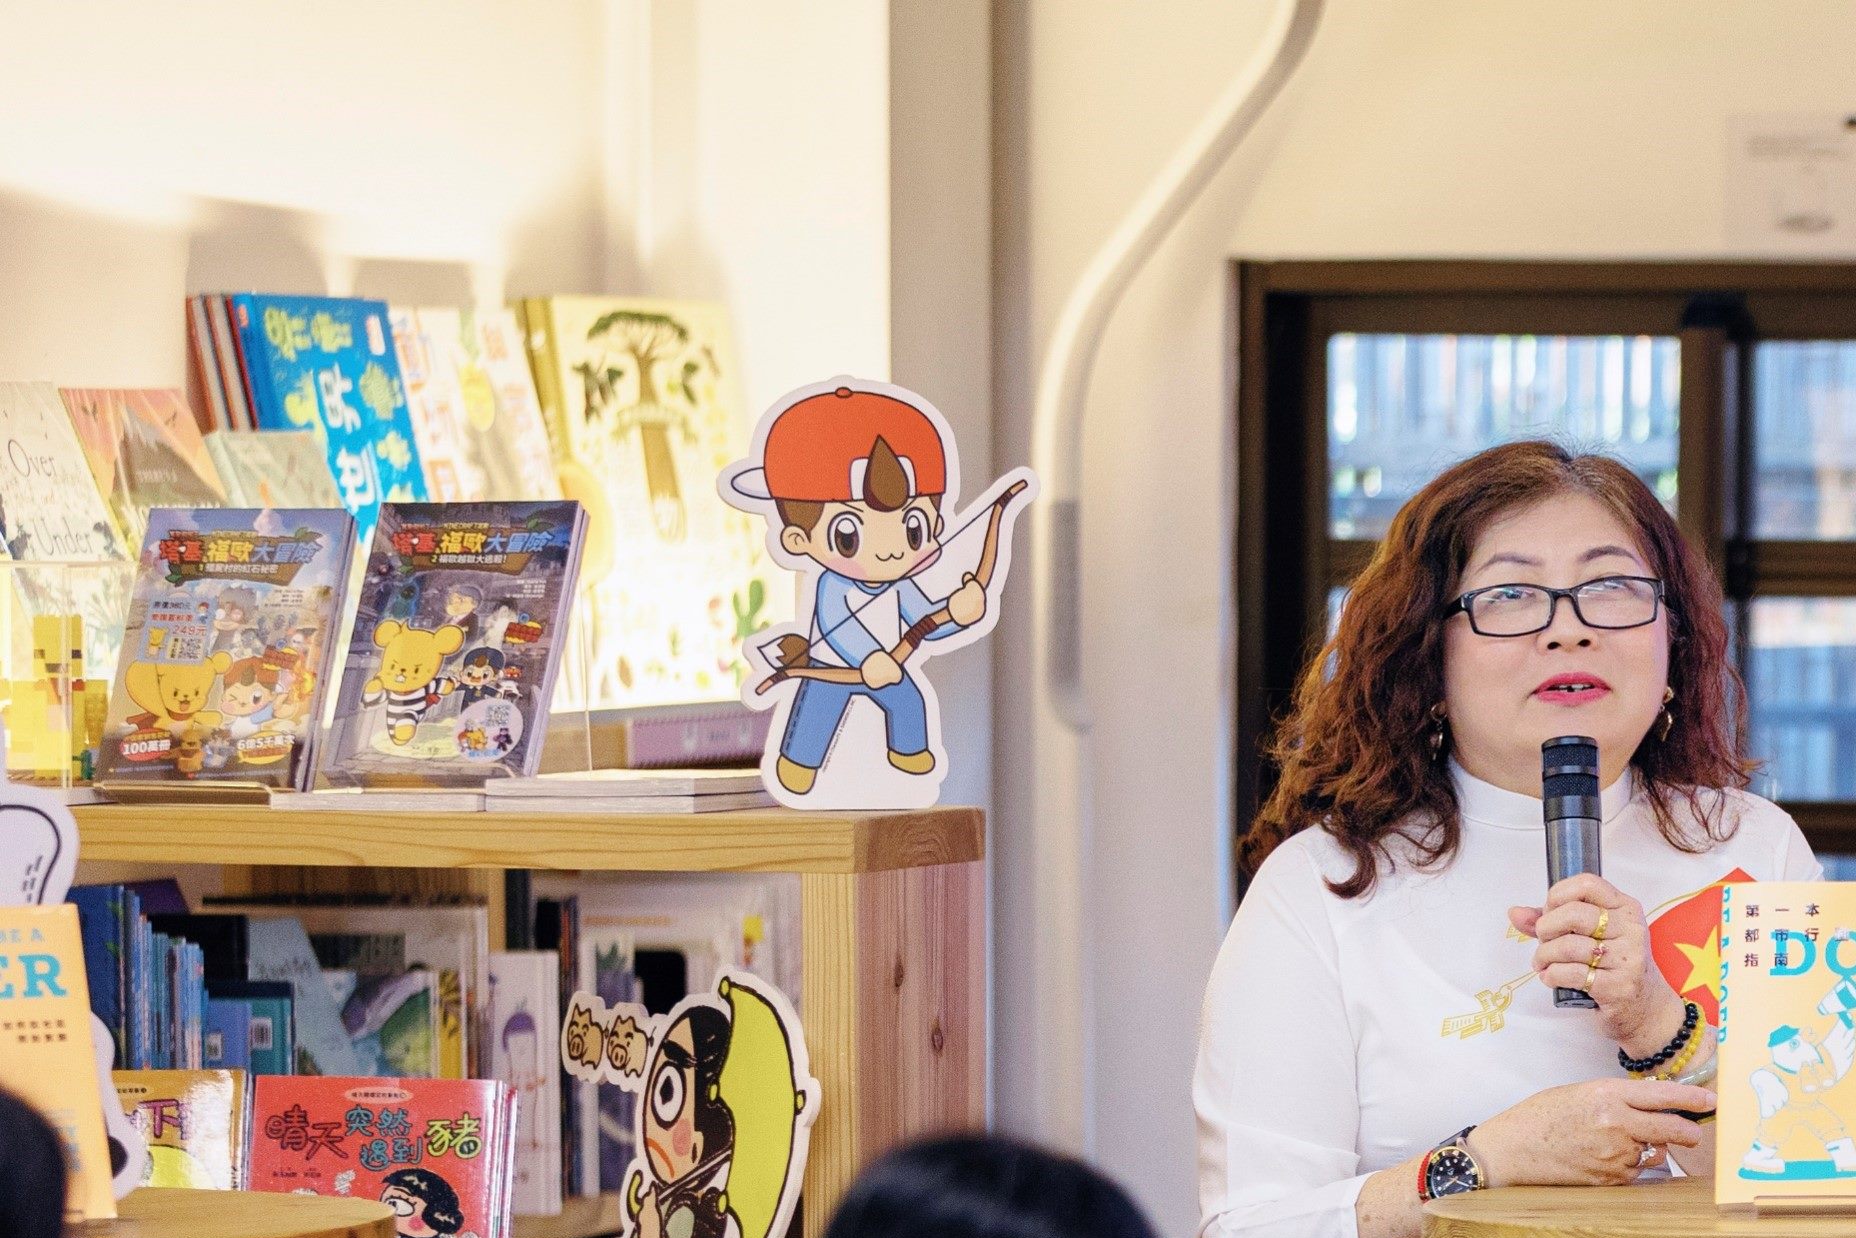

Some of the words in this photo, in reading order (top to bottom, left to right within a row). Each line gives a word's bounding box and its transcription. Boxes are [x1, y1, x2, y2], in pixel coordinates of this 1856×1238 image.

[8, 438, 55, 478] Over
[1745, 903, 1819, 917] 第一本
[30, 928, 45, 942] A
[1744, 953, 1788, 968] 指南
[265, 1104, 349, 1161] 晴天
[345, 1104, 413, 1137] 突然
[425, 1112, 483, 1159] 豬
[359, 1137, 424, 1171] 遇到
